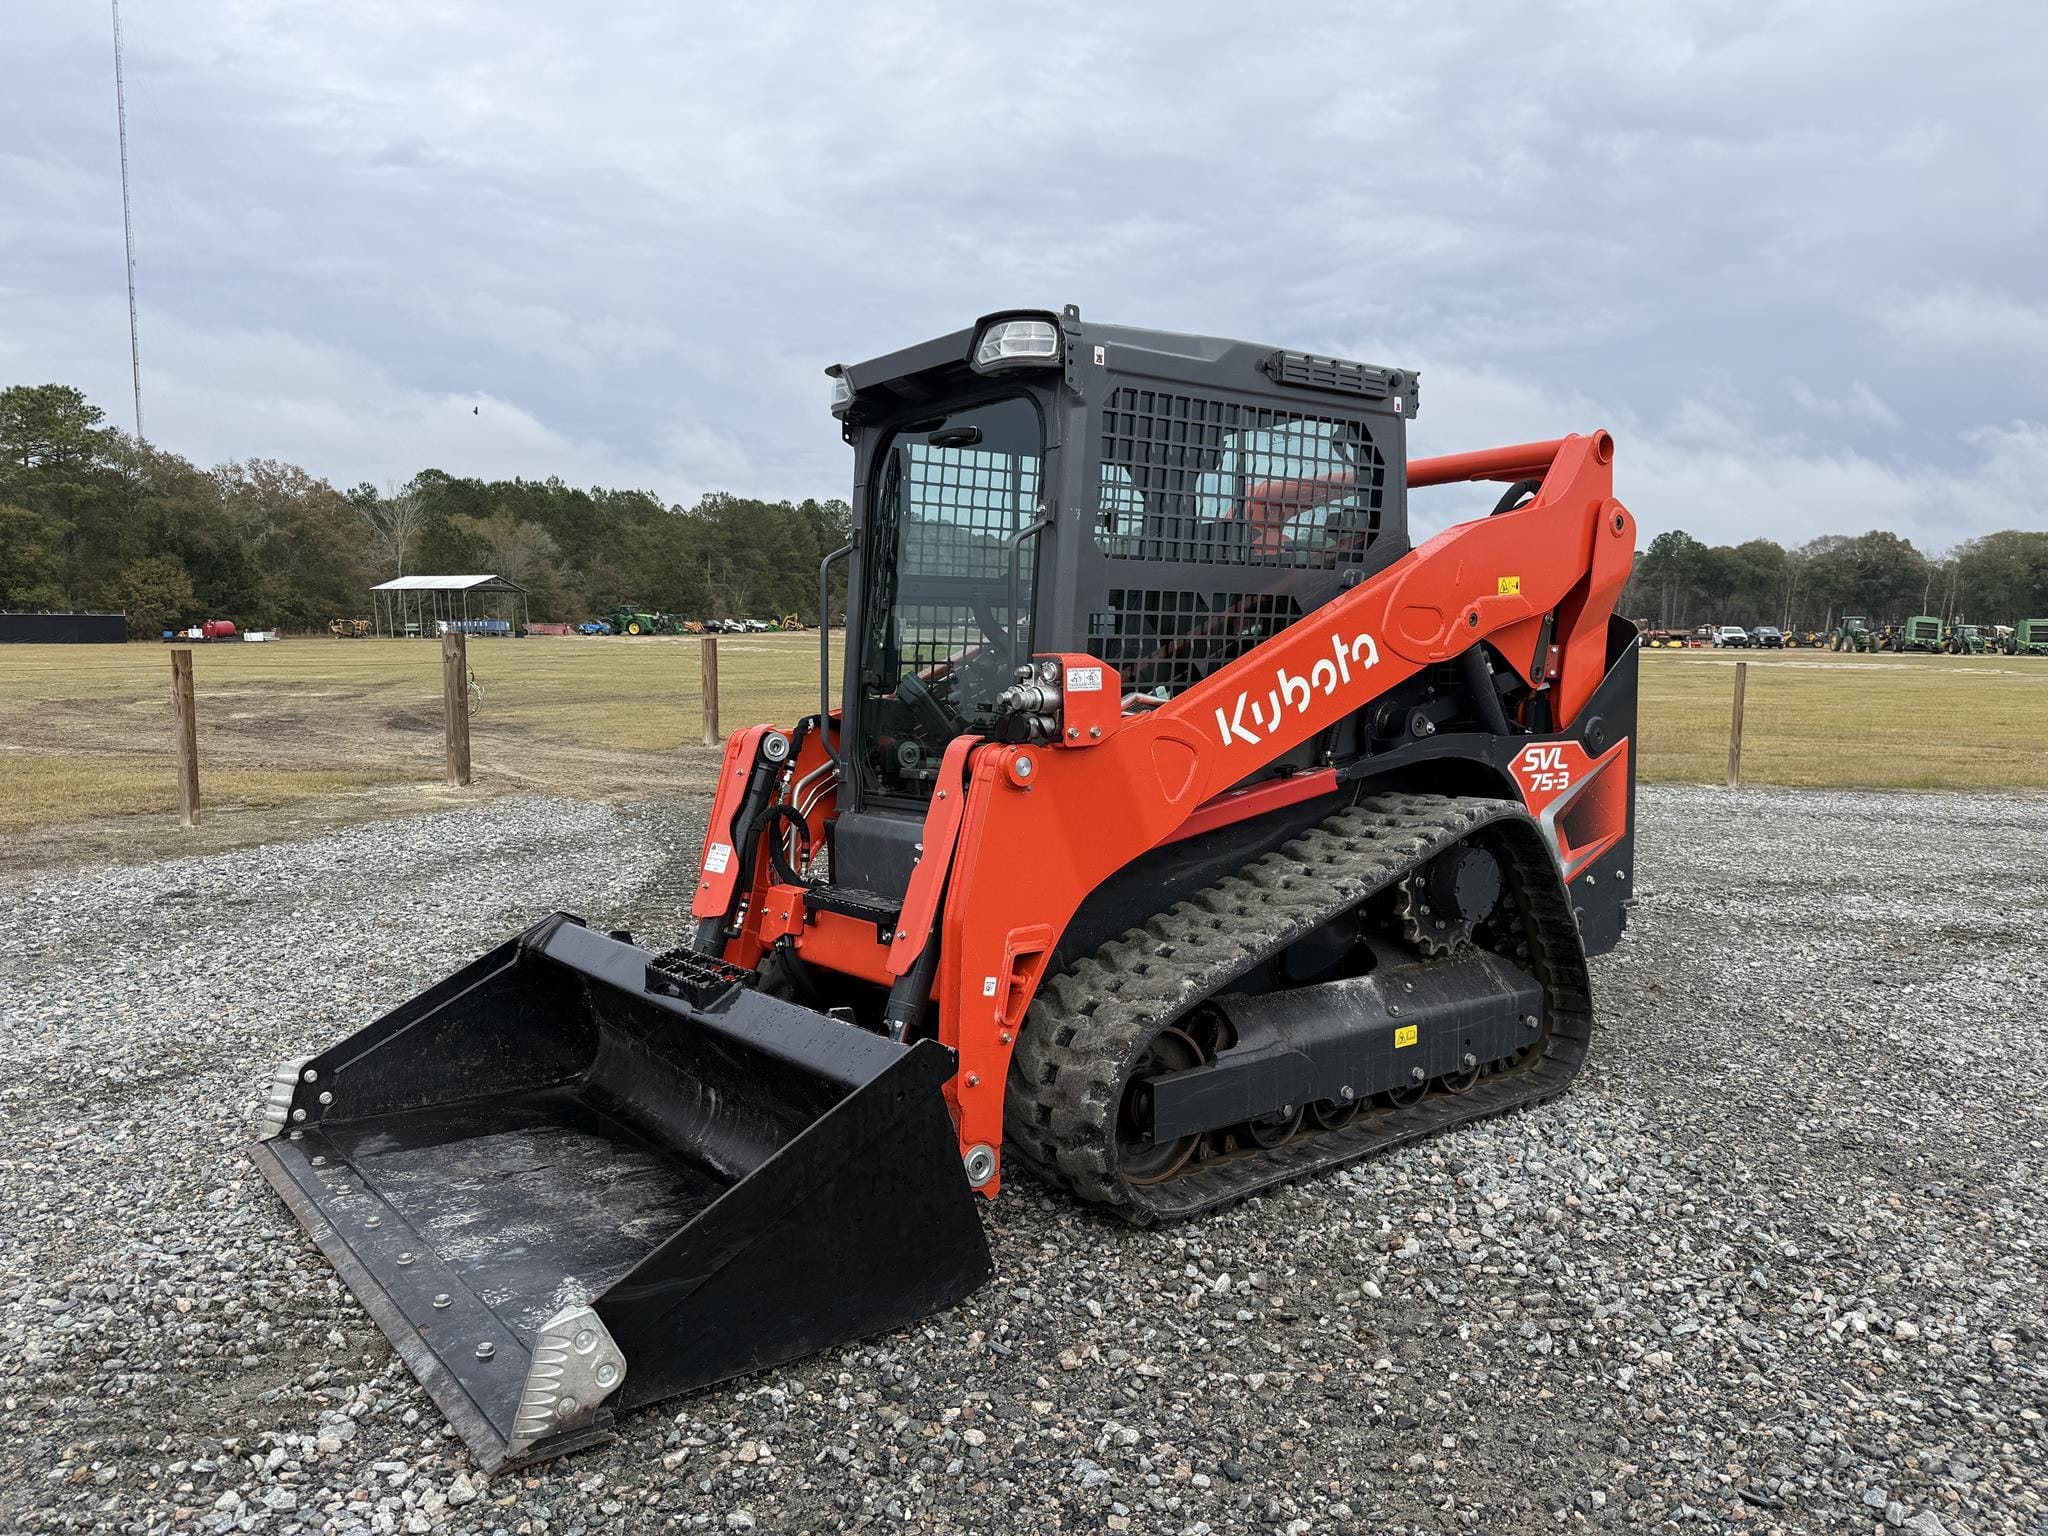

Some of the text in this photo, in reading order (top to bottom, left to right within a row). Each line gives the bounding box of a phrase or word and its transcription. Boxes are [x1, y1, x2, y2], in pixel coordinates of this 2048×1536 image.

[1215, 633, 1380, 746] Kubota
[1522, 747, 1569, 772] SVL
[1530, 771, 1570, 793] 75-3
